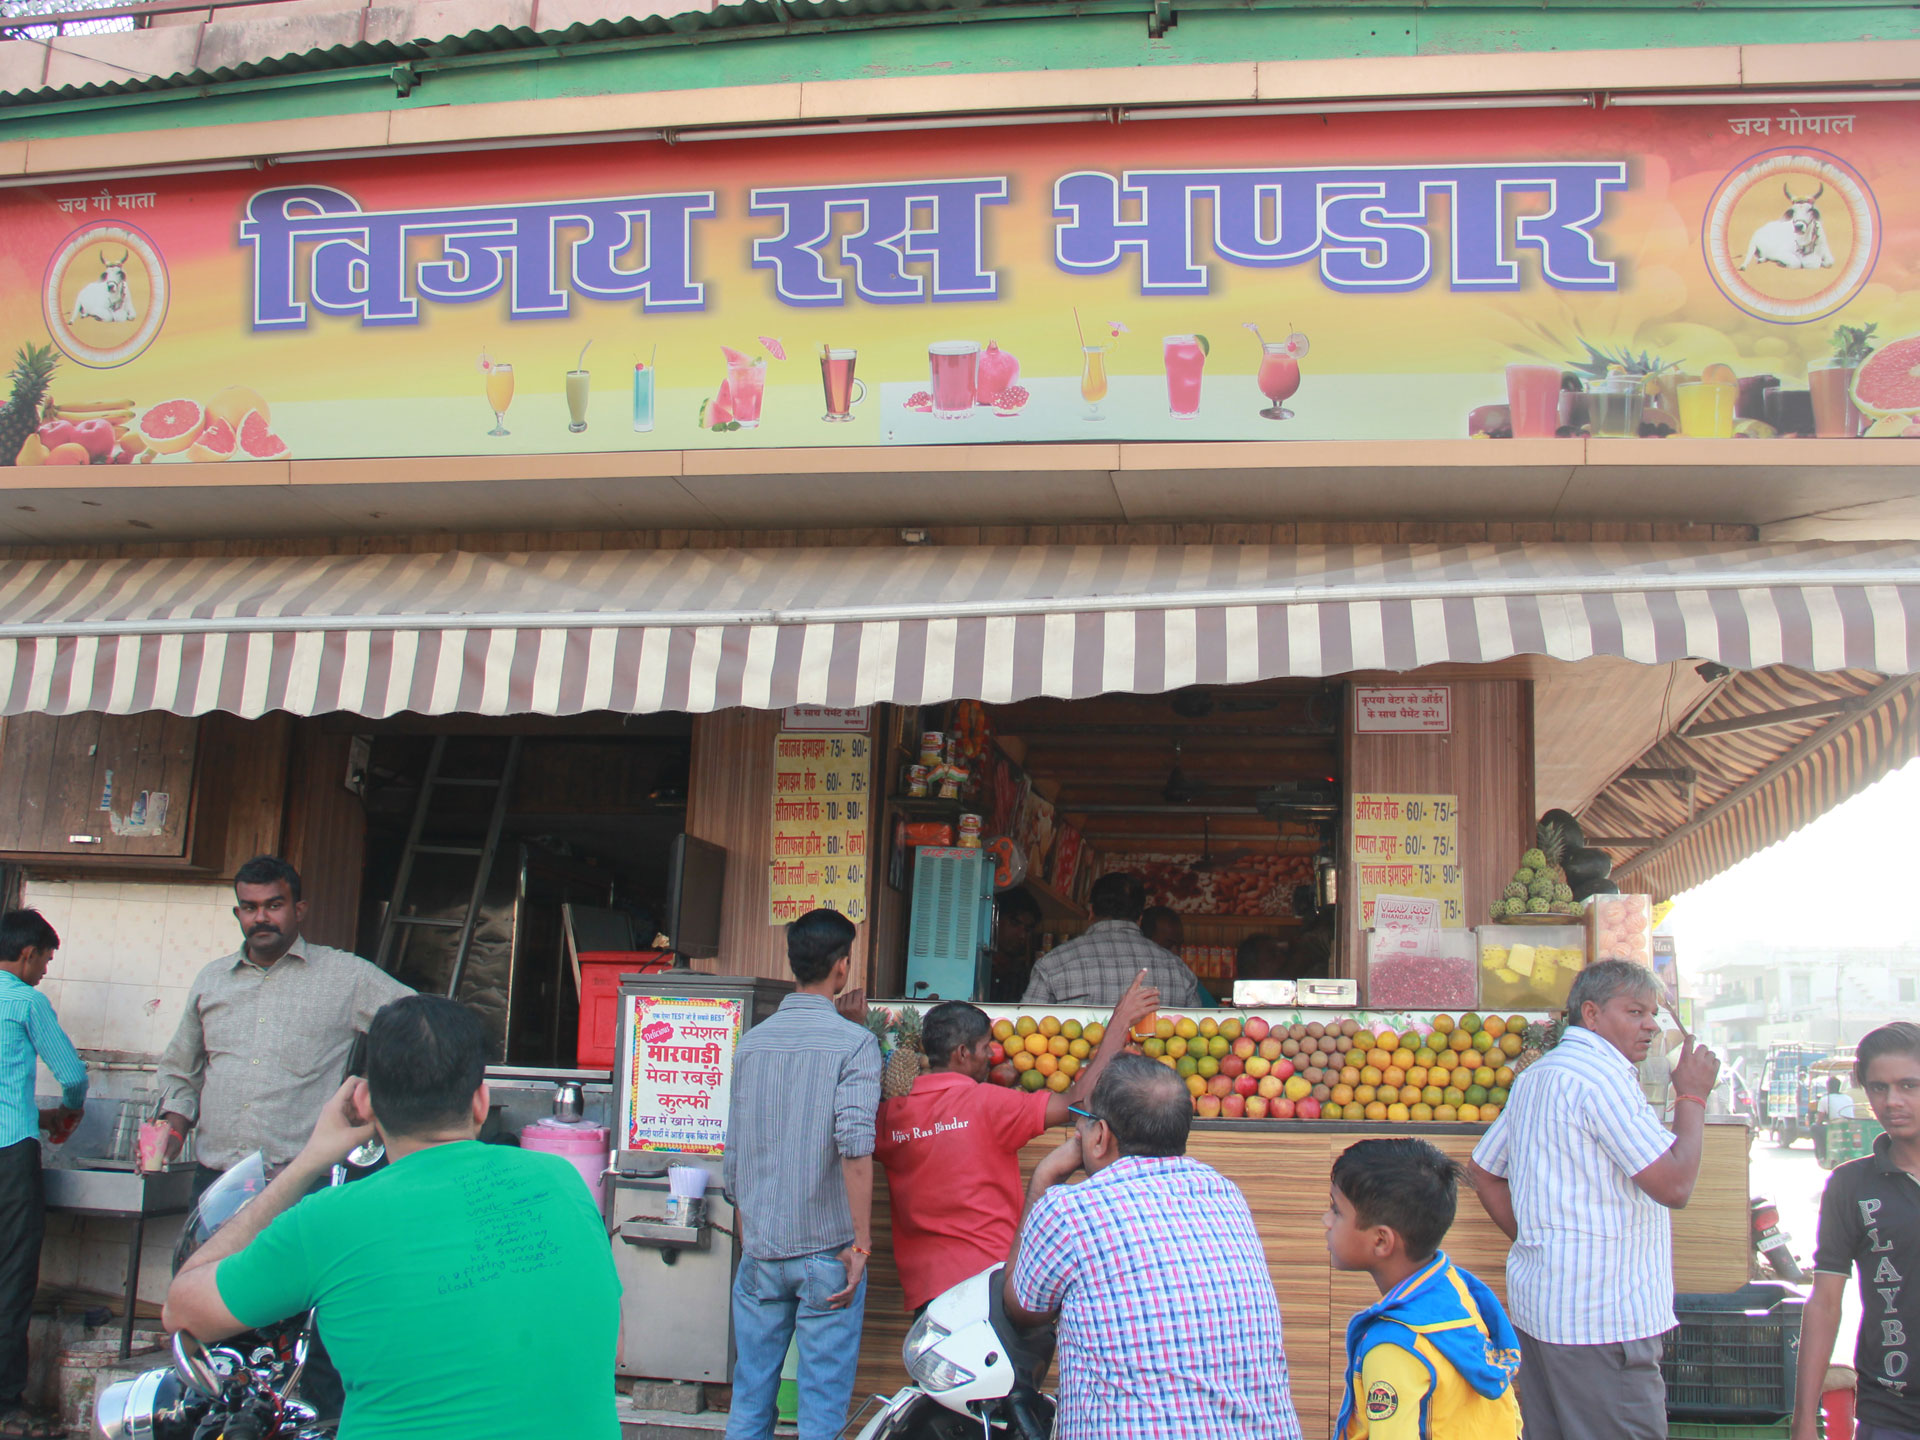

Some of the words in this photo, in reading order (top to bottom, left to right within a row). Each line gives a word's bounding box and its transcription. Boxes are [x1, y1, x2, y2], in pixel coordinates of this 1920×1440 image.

[1728, 117, 1771, 136] जय
[1776, 108, 1856, 135] गोपाल
[57, 197, 88, 213] जय
[91, 188, 113, 211] गौ
[115, 192, 157, 210] माता
[240, 184, 716, 331] विजय
[749, 175, 1009, 306] रस
[1053, 161, 1628, 295] भण्डार
[1361, 696, 1385, 706] कृपया
[1388, 693, 1405, 704] वेटर
[1407, 693, 1418, 704] को
[1367, 707, 1375, 719] के
[1377, 710, 1397, 719] साथ
[779, 739, 801, 757] लबालब
[802, 739, 826, 760] झमाझम
[830, 739, 846, 758] 75/-
[852, 739, 867, 758] 90/-
[777, 772, 801, 792] झमाझम
[804, 767, 816, 791] शेक
[826, 772, 842, 791] 60/-
[851, 772, 866, 791] 75/-
[775, 797, 805, 821] सीताफल
[805, 796, 820, 821] शेक
[826, 801, 842, 821] 70/-
[847, 801, 863, 820] 90/-
[1383, 796, 1400, 820] शेक
[1406, 801, 1427, 821] 60/-
[1433, 802, 1454, 822] 75/-
[775, 831, 804, 855] सीताफल
[805, 830, 822, 856] क्रीम
[827, 835, 844, 854] 60/-
[846, 829, 865, 856] (कप)
[1405, 835, 1426, 855] 60/-
[1433, 836, 1454, 855] 75/-
[773, 861, 787, 885] मीठी
[788, 860, 805, 885] लस्सी
[825, 865, 840, 885] 30/-
[847, 864, 863, 883] 40/-
[1362, 865, 1386, 885] लबालब
[1387, 865, 1413, 886] झमाझम
[1419, 865, 1436, 884] 75/-
[772, 895, 797, 919] नमकीन
[847, 899, 863, 918] 40/-
[1444, 899, 1461, 920] 75/-
[1653, 941, 1672, 952] ilas
[671, 1012, 684, 1020] TEST
[644, 1026, 670, 1041] Delicious
[679, 1021, 729, 1041] स्पेशल
[647, 1042, 722, 1069] मारवाड़ी
[644, 1063, 679, 1084] मेवा
[680, 1067, 724, 1090] रबड़ी
[656, 1090, 712, 1114] कुल्फी
[640, 1115, 656, 1124] व्रत
[658, 1113, 668, 1125] में
[670, 1114, 694, 1126] खाने
[696, 1115, 722, 1128] योग्य
[912, 1126, 933, 1139] Ras
[1858, 1198, 1908, 1397] PLAYBOY
